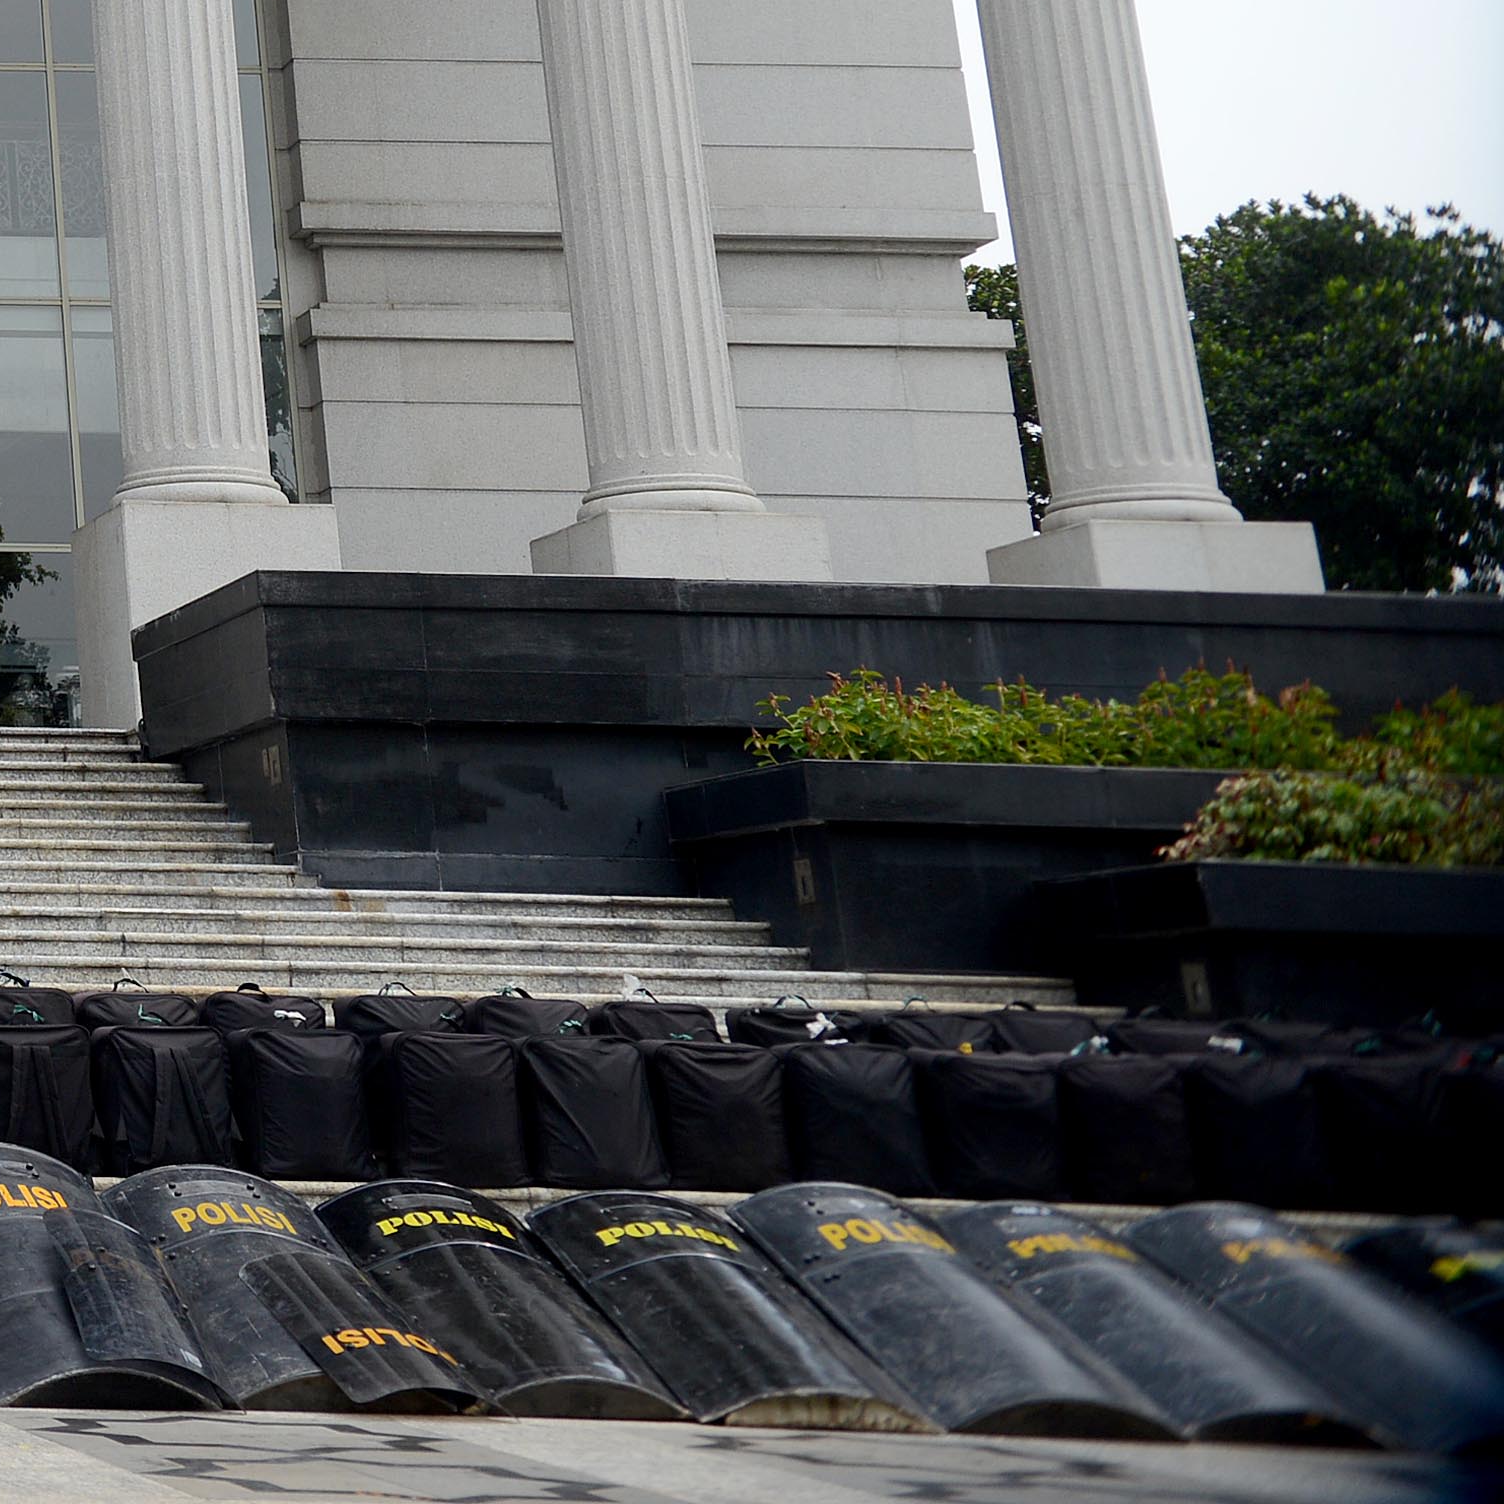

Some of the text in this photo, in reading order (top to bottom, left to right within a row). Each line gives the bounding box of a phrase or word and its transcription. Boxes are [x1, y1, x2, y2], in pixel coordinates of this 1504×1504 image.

[171, 1201, 299, 1235] POLISI
[375, 1210, 517, 1241] POLISI
[594, 1221, 741, 1253] POLISI
